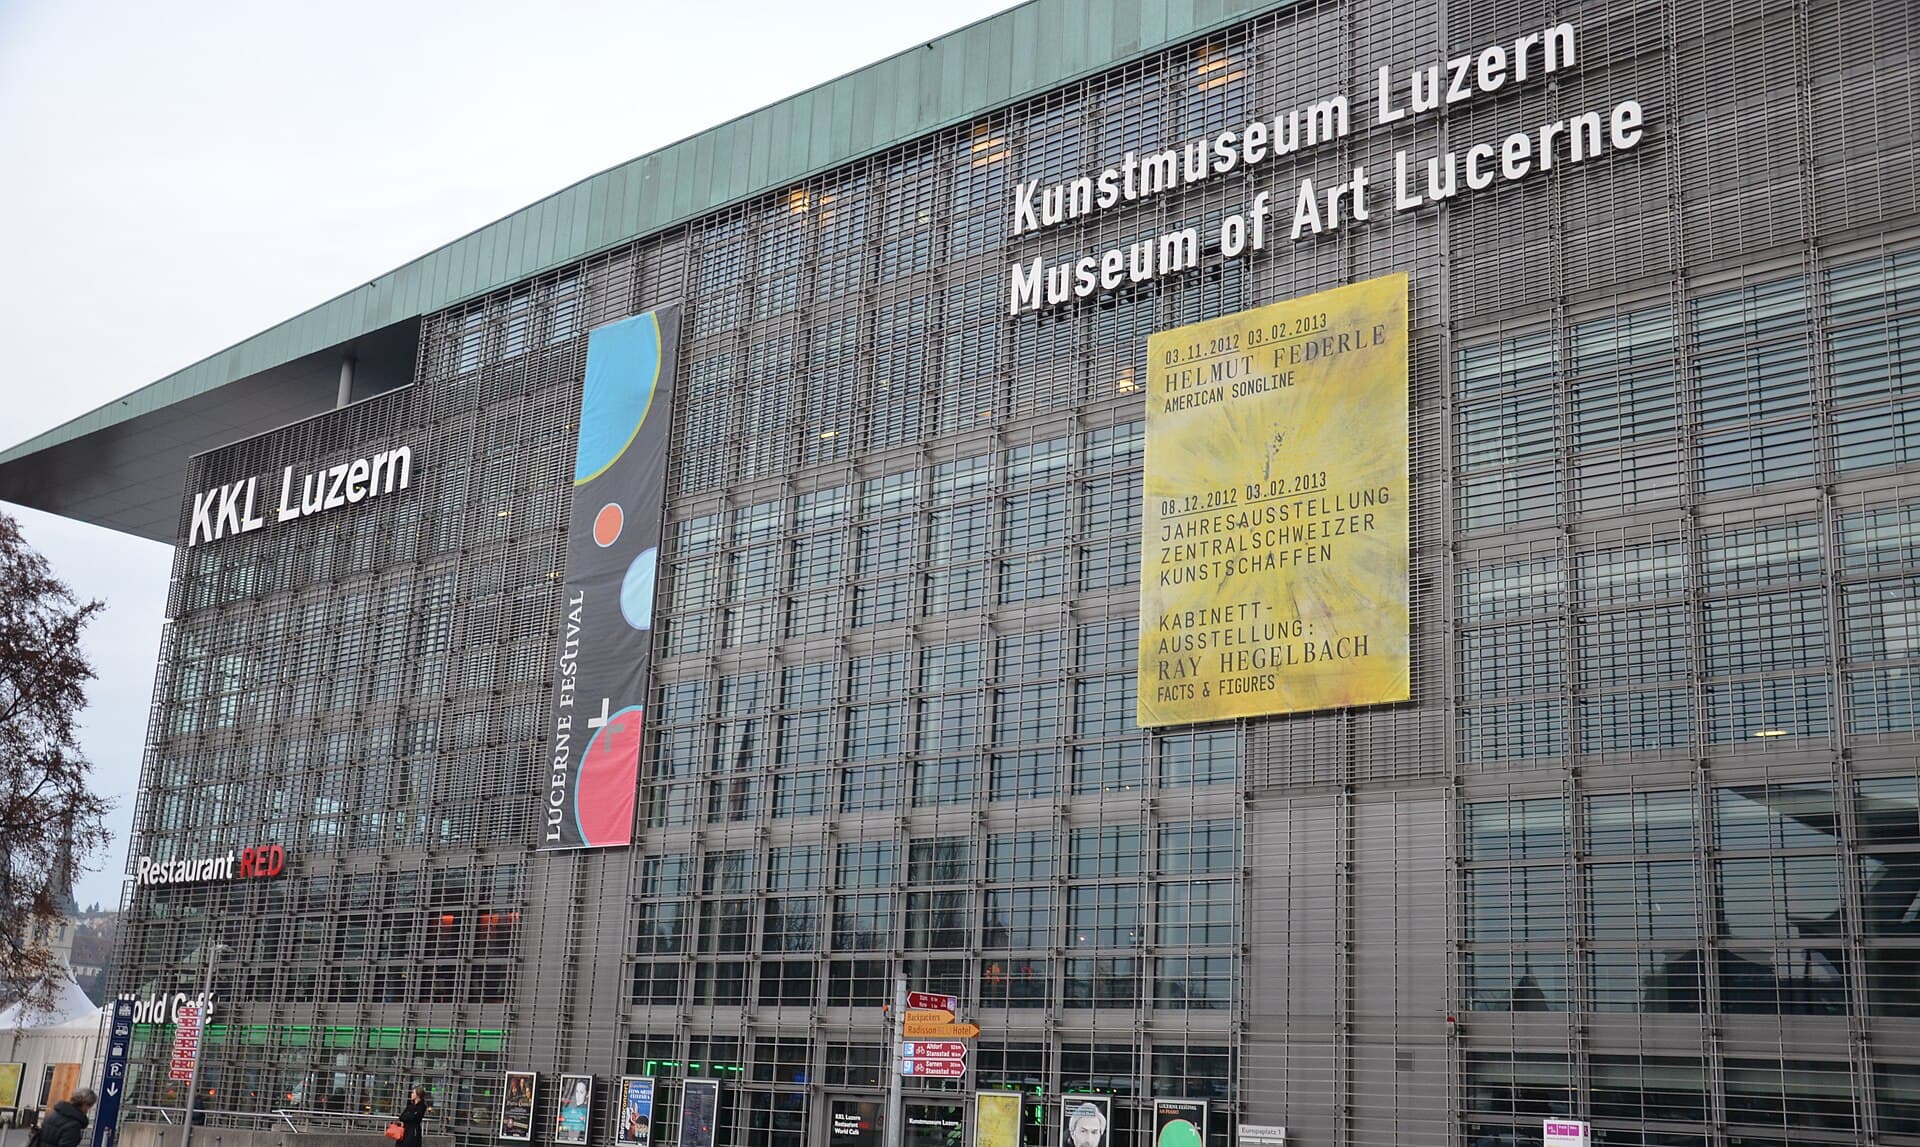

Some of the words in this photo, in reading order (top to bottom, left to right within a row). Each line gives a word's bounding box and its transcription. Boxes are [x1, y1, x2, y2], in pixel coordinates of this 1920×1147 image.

[1013, 92, 1348, 236] Kunstmuseum
[1378, 21, 1575, 125] Luzern
[1009, 226, 1196, 316] Museum
[1221, 190, 1269, 259] of
[1291, 167, 1370, 240] Art
[1395, 99, 1644, 211] Lucerne
[1165, 334, 1240, 366] 03.11.2012
[1248, 313, 1327, 346] 03.02.2013
[1165, 355, 1254, 393] HELMUT
[1274, 324, 1386, 369] FEDERLE
[1164, 387, 1224, 414] AMERICAN
[1231, 371, 1295, 398] SONGLINE
[189, 476, 263, 547] KKL
[278, 445, 411, 522] Luzern
[1161, 488, 1237, 517] 08.12.2012
[1246, 471, 1327, 501] 03.02.2013
[1161, 486, 1390, 542] JAHRESAUSSTELLUNG
[1160, 513, 1375, 564] ZENTRALSCHWEIZER
[1160, 544, 1332, 587] KUNSTSCHAFFEN
[1158, 619, 1315, 655] AUSSTELLUNG:
[1159, 601, 1273, 632] KABINETT-
[1158, 656, 1202, 681] RAY
[1220, 634, 1369, 674] HEGELBACH
[1157, 683, 1195, 703] FACTS
[1202, 681, 1210, 697] &
[1219, 674, 1276, 696] FIGURES
[546, 714, 572, 842] LUCERNE
[559, 590, 585, 709] FESTIVAL
[136, 850, 235, 886] Restaurant
[240, 845, 285, 879] RED
[907, 1012, 941, 1022] Backpackers
[908, 1025, 937, 1034] Radisson
[953, 1025, 971, 1034] Hotel
